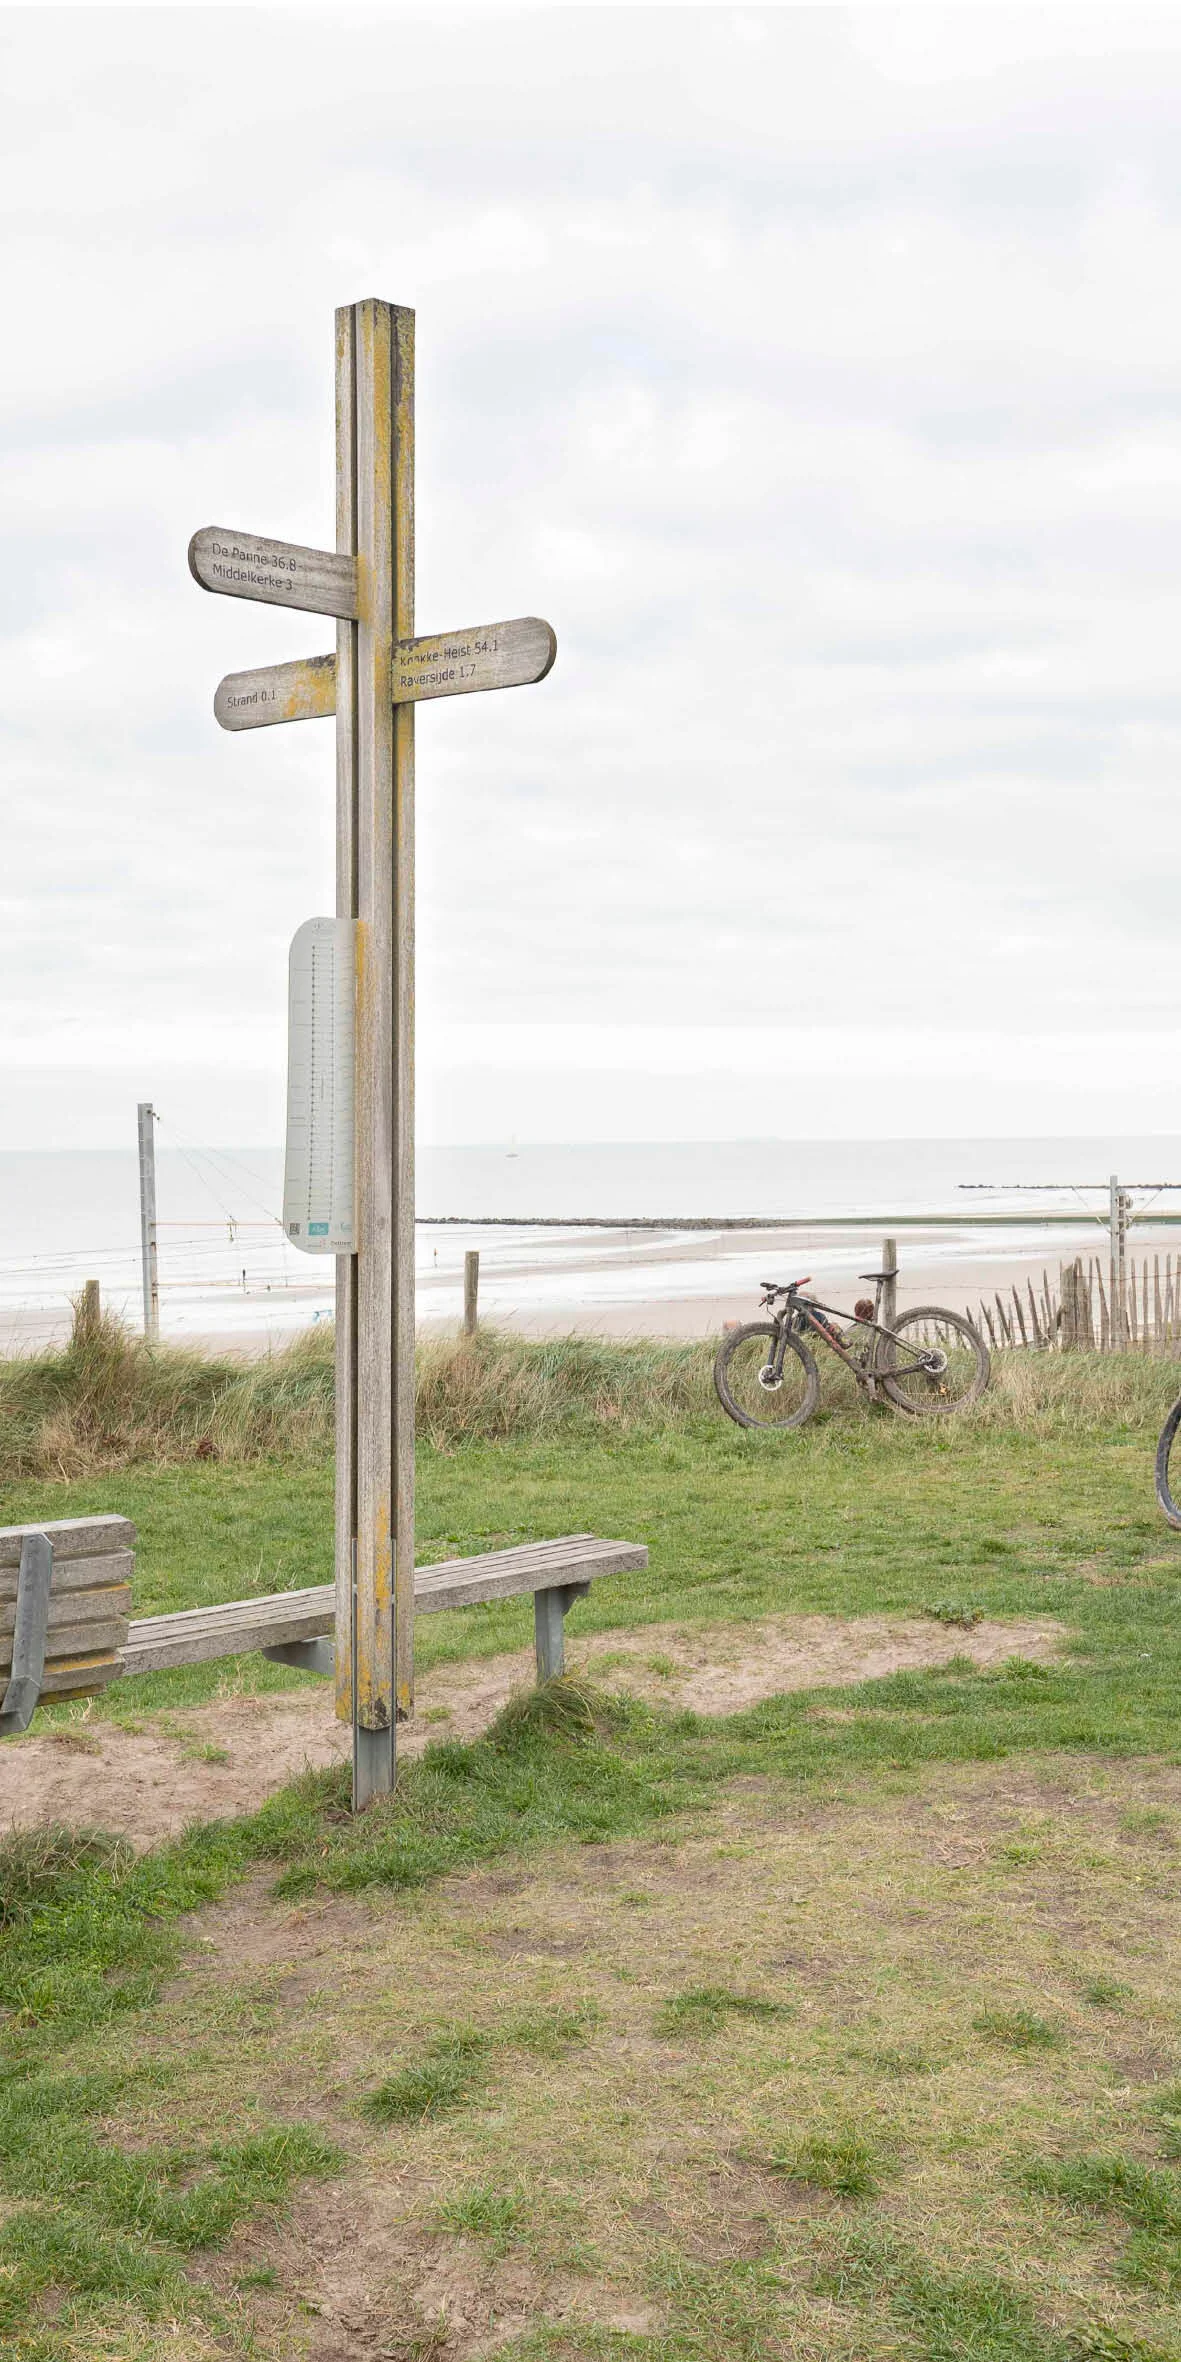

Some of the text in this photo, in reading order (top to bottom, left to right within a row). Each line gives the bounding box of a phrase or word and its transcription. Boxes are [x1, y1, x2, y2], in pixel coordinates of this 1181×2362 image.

[212, 543, 297, 572] De Panne 36.8
[212, 563, 293, 591] Middelkerke 3
[474, 639, 498, 655] 54.1
[400, 664, 476, 688] Raversijde 1.7
[227, 689, 275, 709] Strand 0.1
